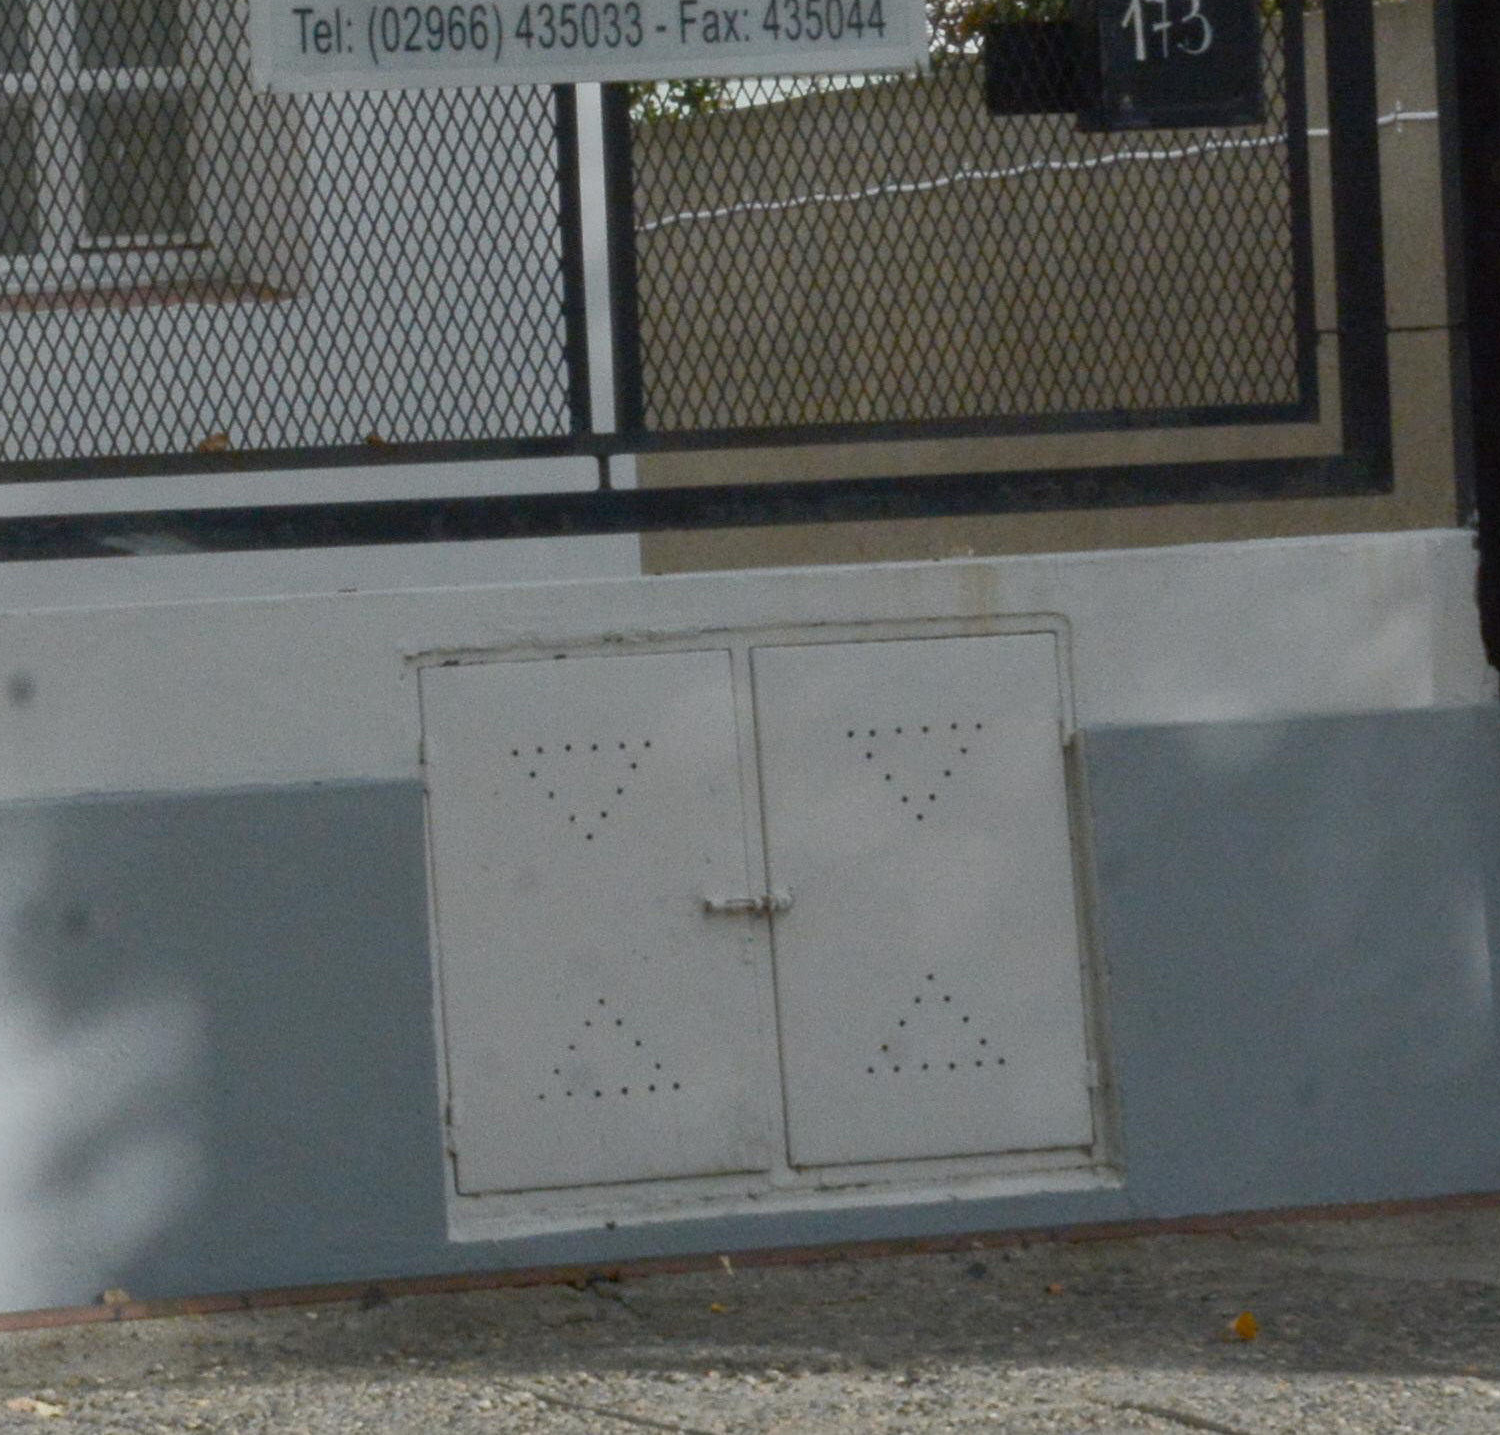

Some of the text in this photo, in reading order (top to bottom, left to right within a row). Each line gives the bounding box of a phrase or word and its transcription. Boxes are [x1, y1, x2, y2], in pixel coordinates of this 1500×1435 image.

[292, 7, 354, 55] Tel:
[367, 3, 503, 64] (02966)
[515, 0, 644, 50] 435033
